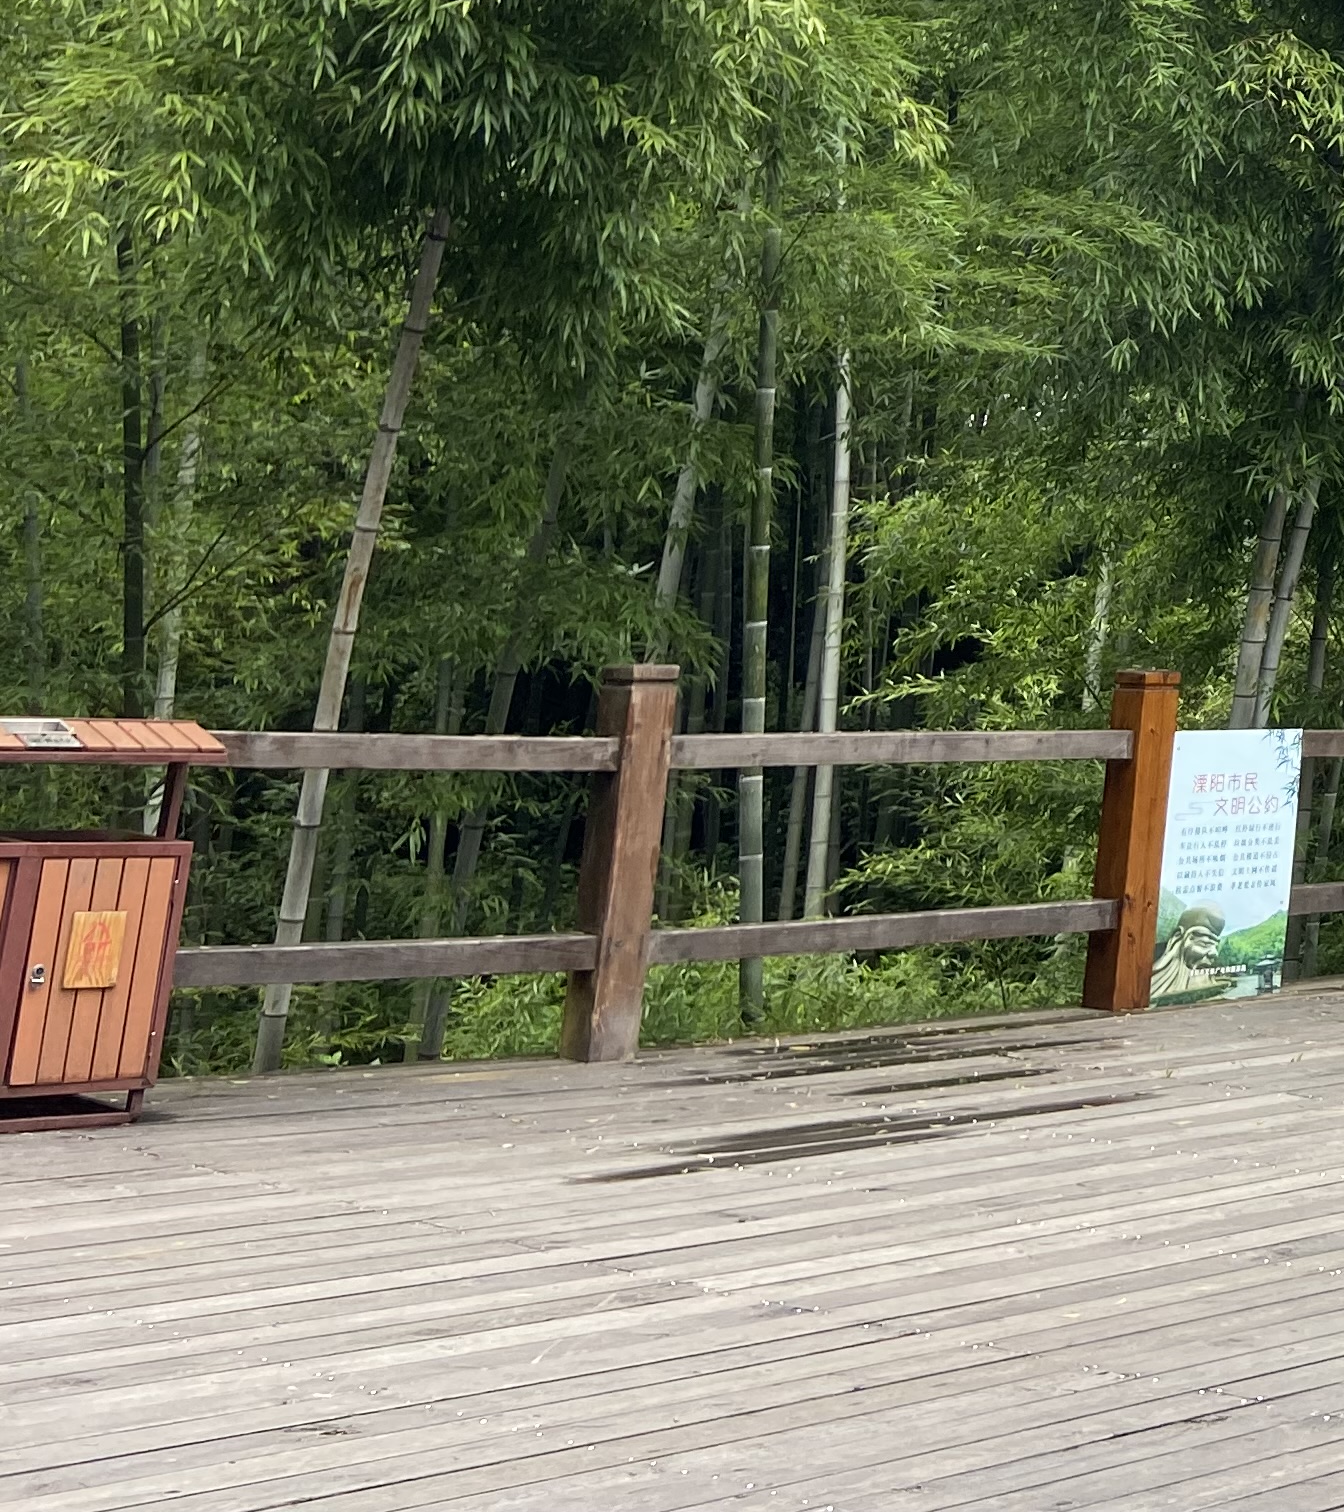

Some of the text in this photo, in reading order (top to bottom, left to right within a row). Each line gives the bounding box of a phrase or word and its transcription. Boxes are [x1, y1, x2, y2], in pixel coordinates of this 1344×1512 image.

[1193, 772, 1258, 793] 溧阳市民
[1213, 795, 1279, 816] 文明公约
